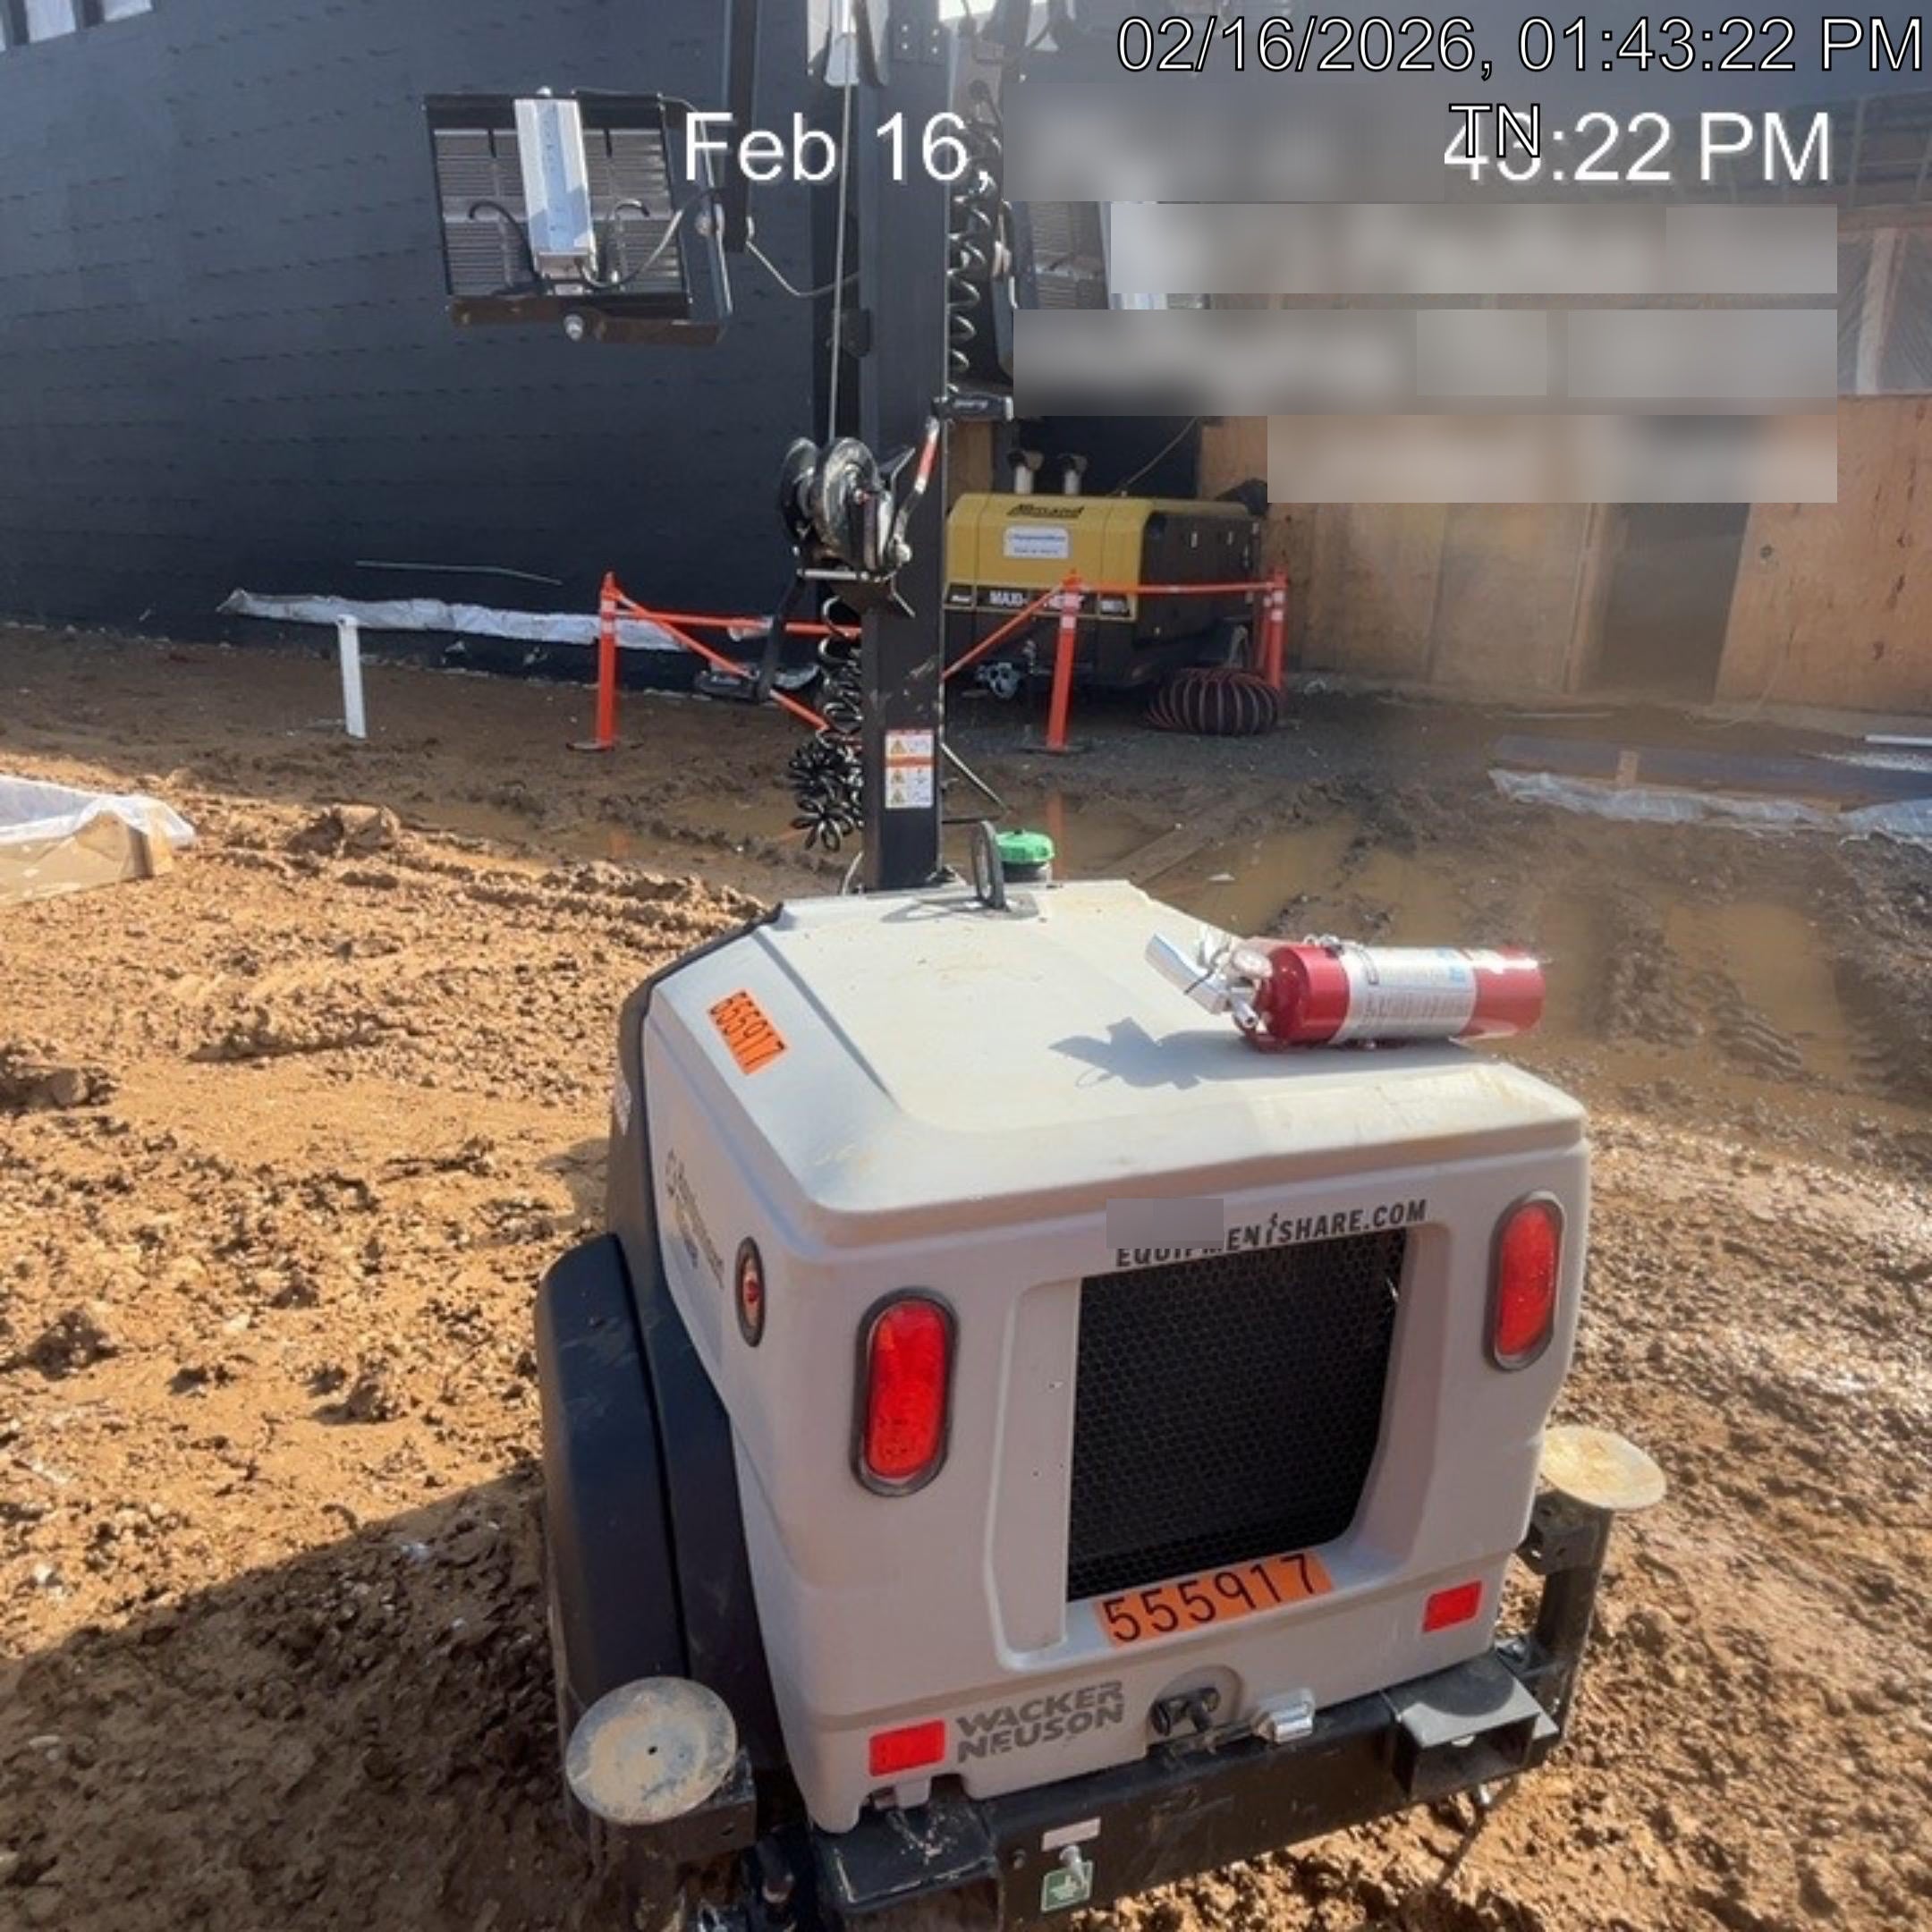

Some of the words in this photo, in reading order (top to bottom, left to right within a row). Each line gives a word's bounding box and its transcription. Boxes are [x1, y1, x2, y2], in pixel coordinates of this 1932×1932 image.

[1102, 1553, 1317, 1643] 555917
[956, 1680, 1124, 1738] WACKER
[956, 1703, 1124, 1764] NEUSON
